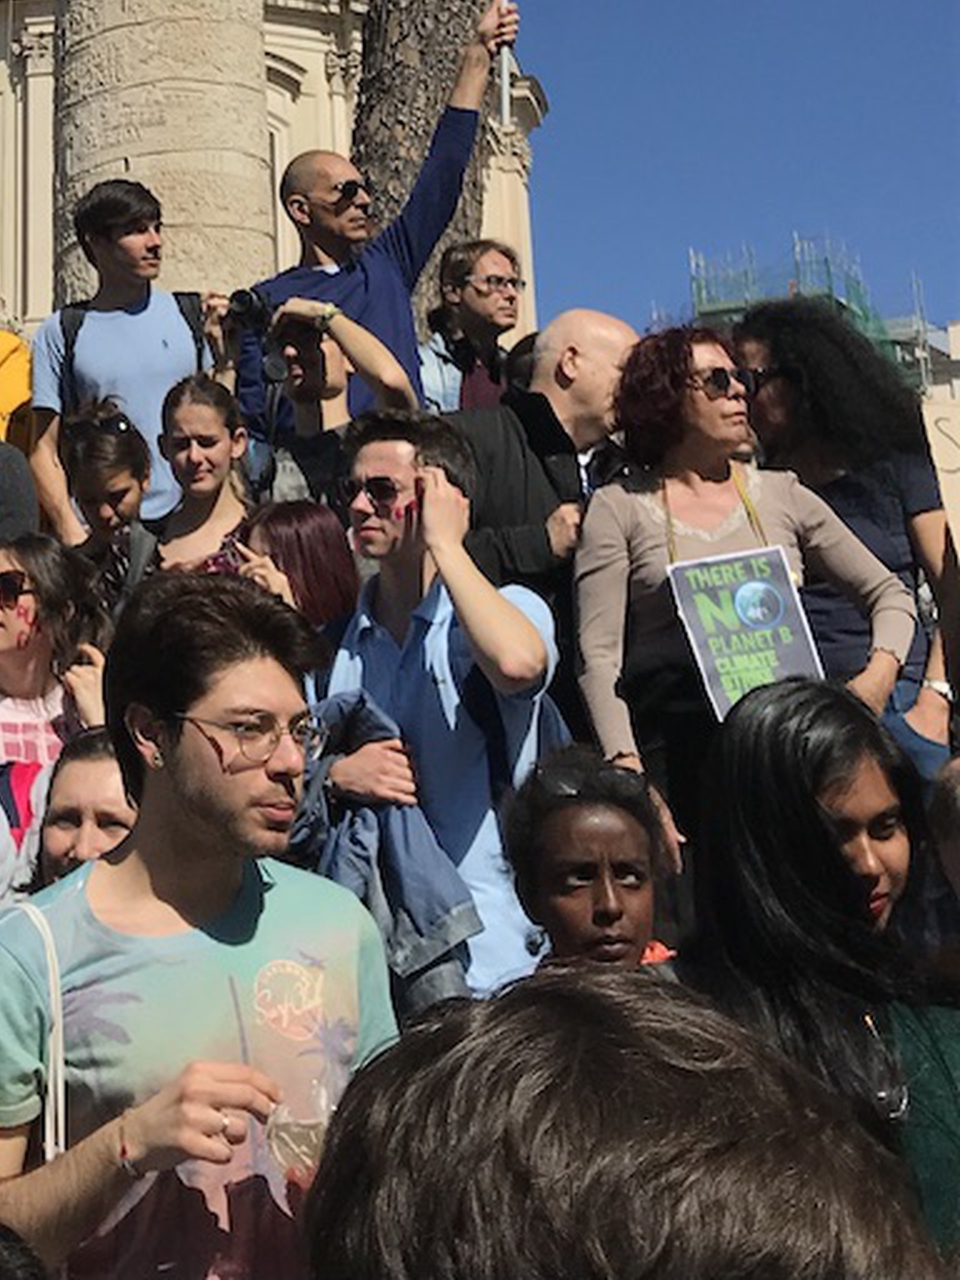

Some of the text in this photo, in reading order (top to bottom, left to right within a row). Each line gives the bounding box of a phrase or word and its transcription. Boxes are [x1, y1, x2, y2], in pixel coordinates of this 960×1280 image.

[684, 557, 771, 591] THERE IS
[707, 628, 776, 657] PLANET
[714, 649, 780, 674] CLIMATE
